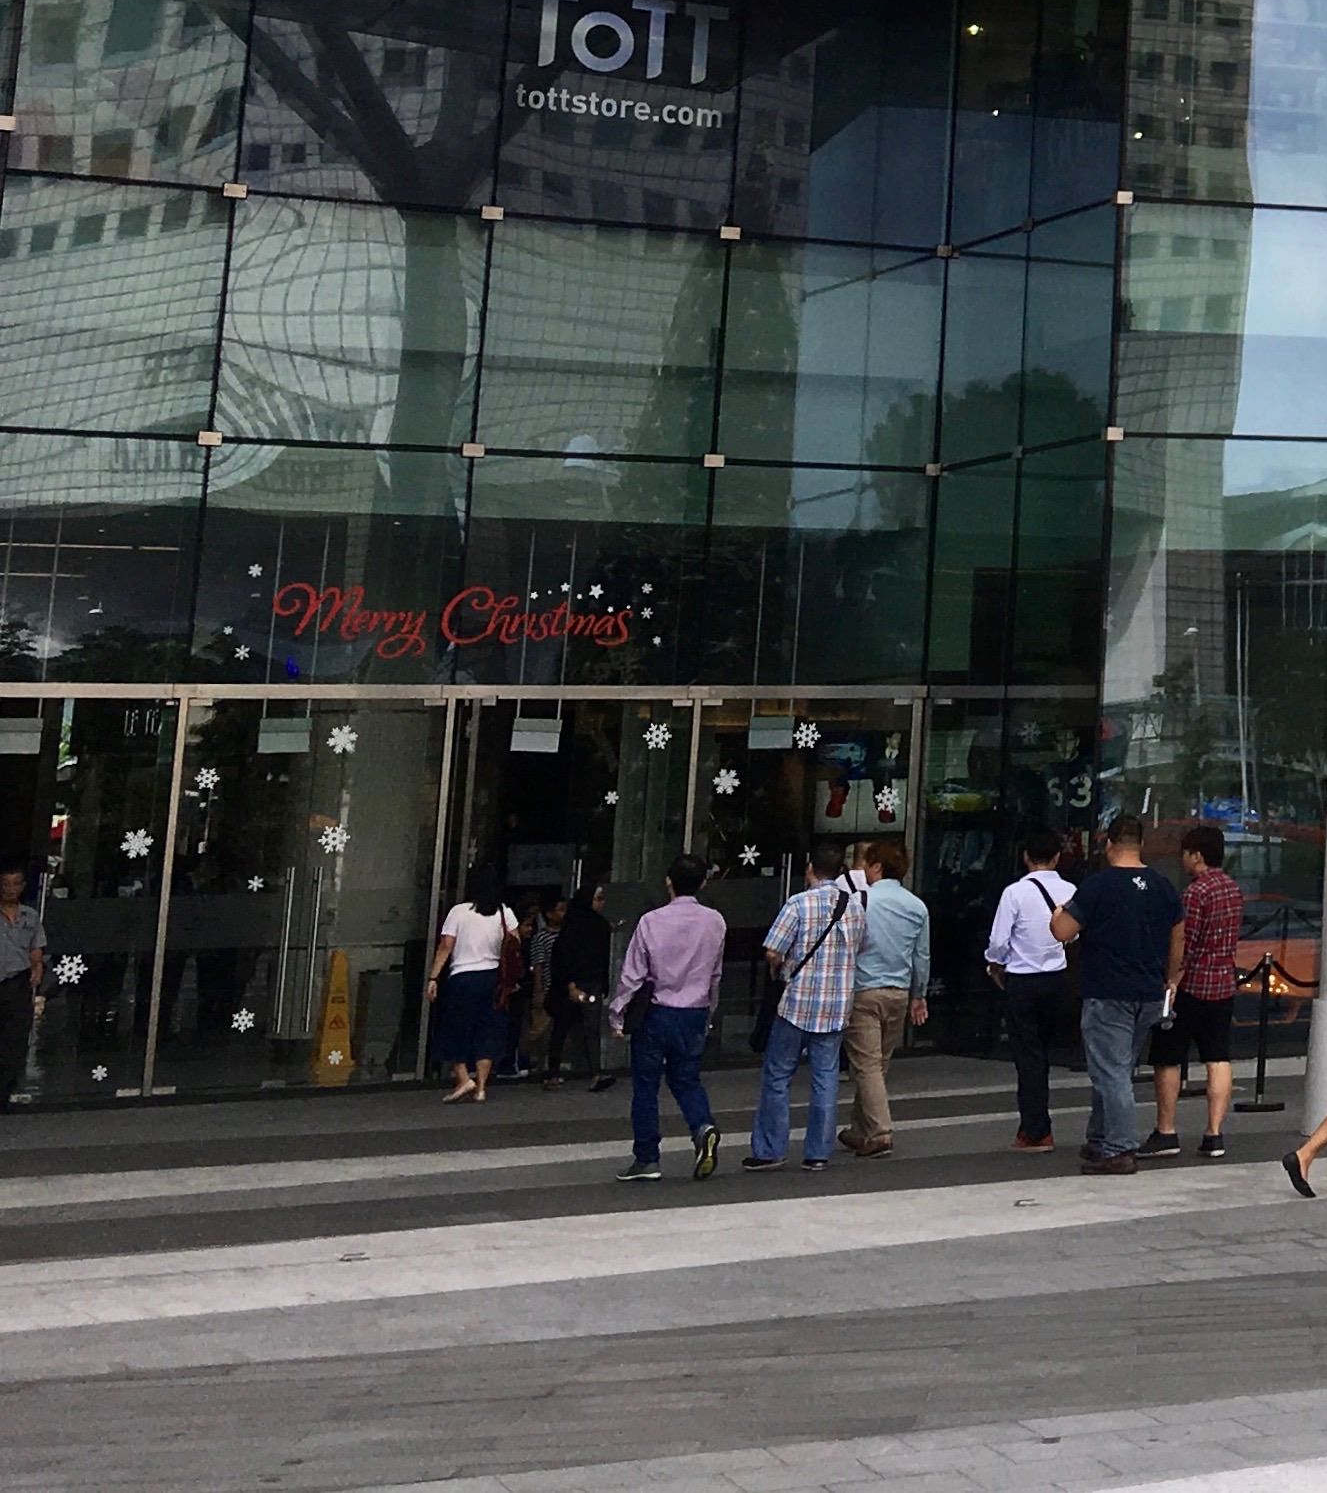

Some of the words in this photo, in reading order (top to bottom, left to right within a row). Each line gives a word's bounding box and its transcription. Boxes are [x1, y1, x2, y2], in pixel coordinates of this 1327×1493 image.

[516, 83, 724, 130] tottstore.com
[273, 582, 428, 659] Merry
[441, 585, 633, 647] Christmas
